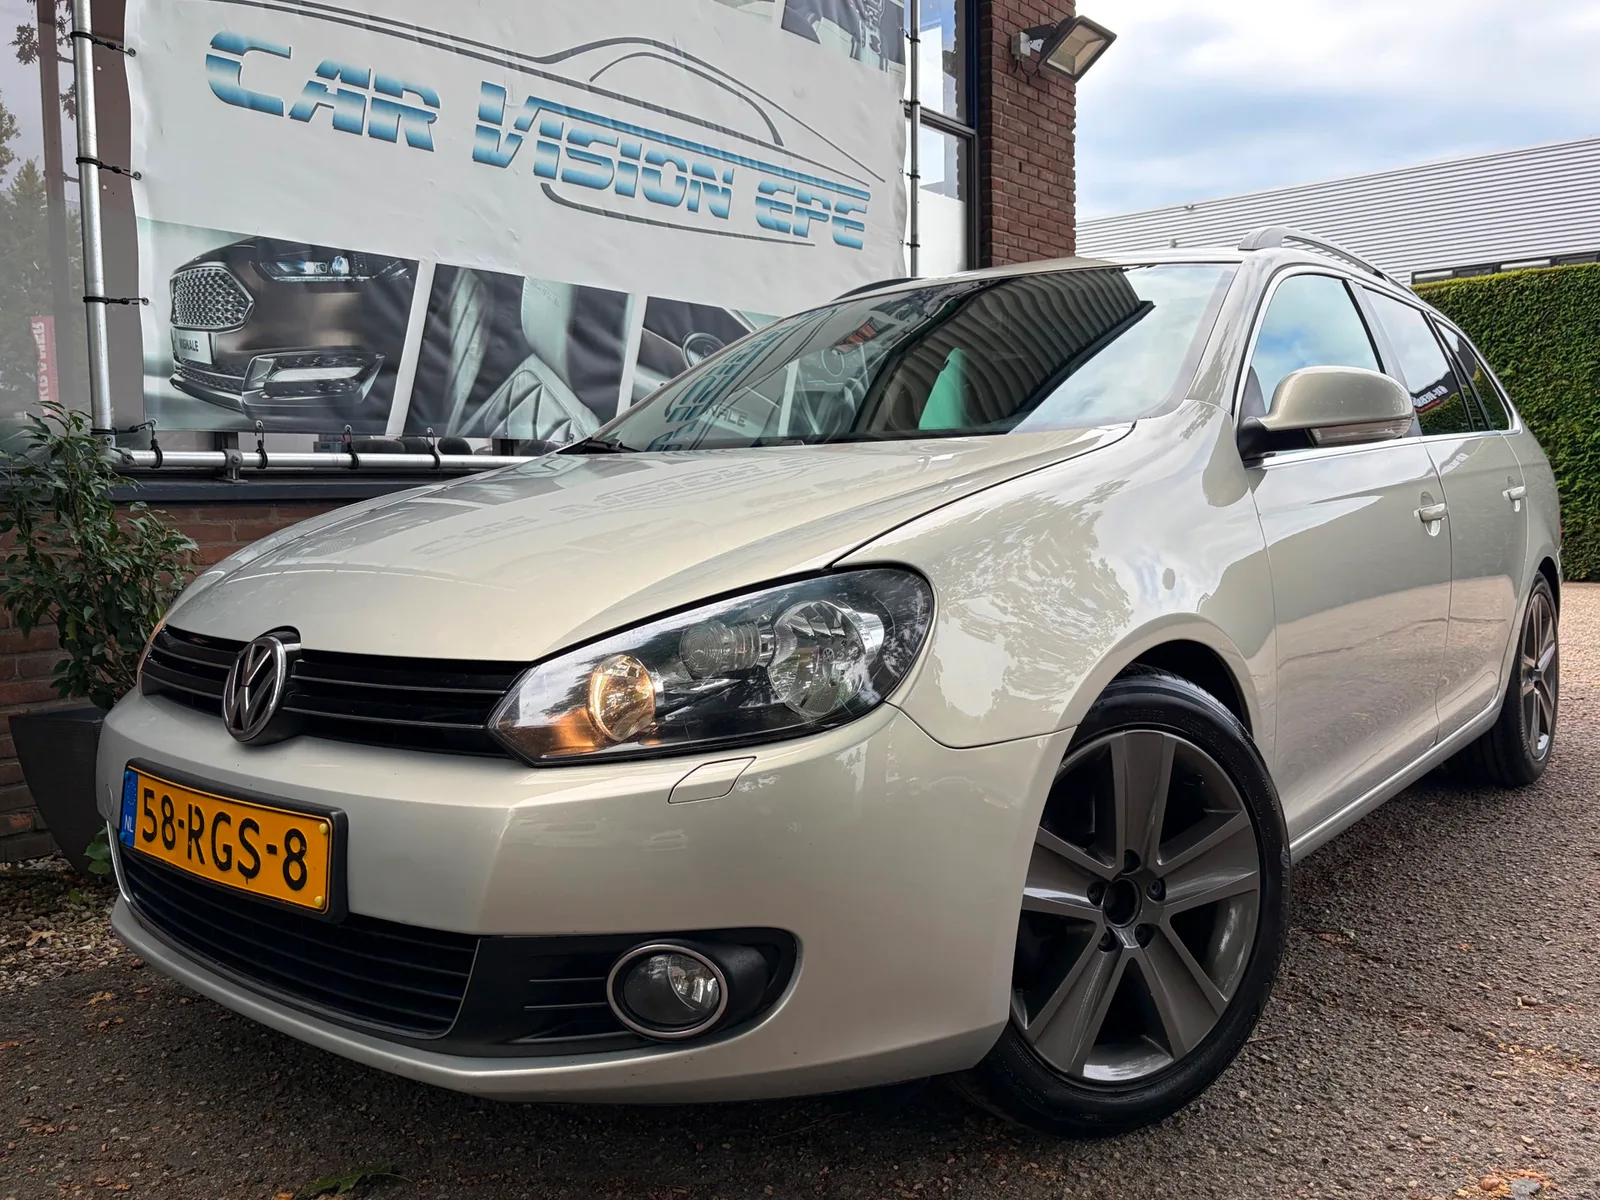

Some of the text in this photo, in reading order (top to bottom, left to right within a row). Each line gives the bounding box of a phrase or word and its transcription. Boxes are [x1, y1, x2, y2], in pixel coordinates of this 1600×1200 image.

[205, 31, 870, 249] CAR VISION EPE
[124, 813, 134, 833] NL
[141, 787, 308, 891] 58-RGS-8
